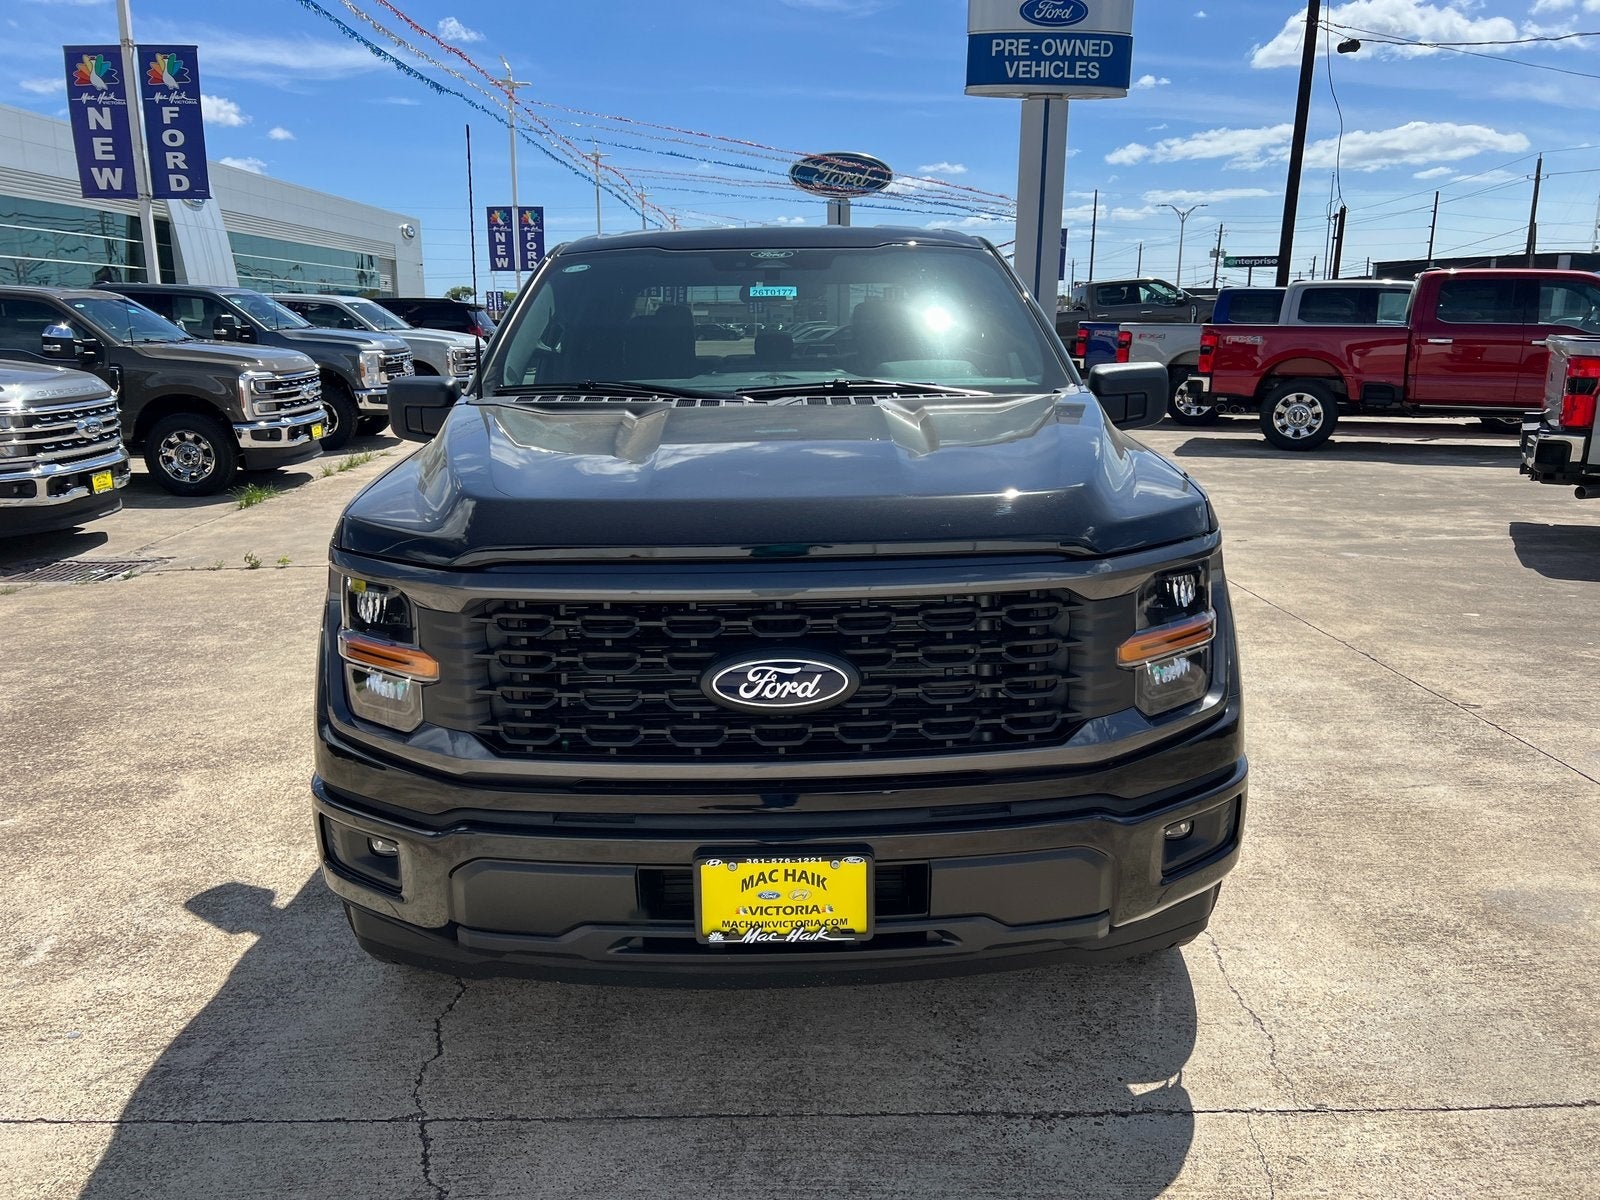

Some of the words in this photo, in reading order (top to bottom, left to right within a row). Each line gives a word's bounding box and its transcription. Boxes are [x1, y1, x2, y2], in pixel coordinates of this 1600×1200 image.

[1033, 0, 1073, 19] Ford
[1005, 61, 1100, 79] VEHICLES
[87, 106, 123, 191] NEW
[161, 106, 190, 192] FORD
[812, 161, 871, 187] Ford
[495, 232, 509, 268] NEW
[526, 232, 537, 269] FORD
[1226, 257, 1279, 266] enterprise
[1226, 335, 1264, 344] FX4
[739, 666, 823, 699] Ford
[741, 869, 779, 893] MAC
[784, 869, 828, 891] HAIK
[748, 904, 821, 916] VICTORIA
[740, 927, 777, 943] Mac
[785, 926, 830, 942] Haik
